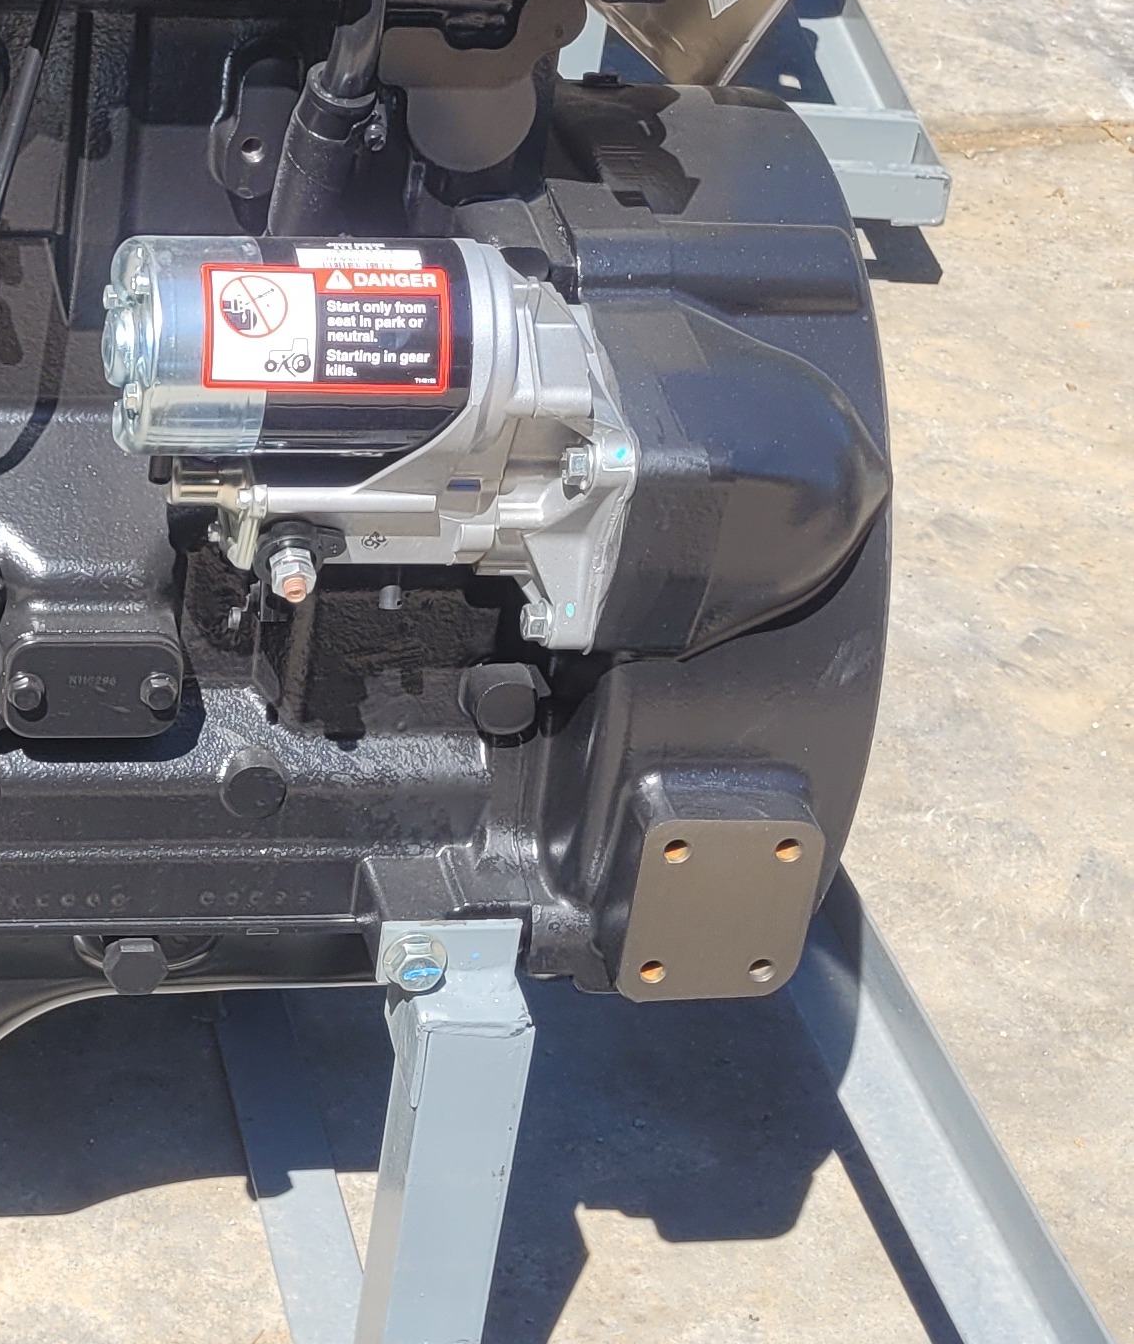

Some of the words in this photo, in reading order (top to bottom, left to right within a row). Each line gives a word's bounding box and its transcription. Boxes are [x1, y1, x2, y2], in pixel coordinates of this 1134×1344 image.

[353, 272, 437, 287] DANGER
[326, 300, 360, 312] Start
[363, 301, 392, 316] only
[394, 301, 426, 313] from
[327, 316, 356, 327] seat
[360, 315, 371, 327] in
[375, 316, 406, 330] park
[409, 319, 423, 328] or
[327, 330, 378, 342] neutral.
[326, 349, 380, 365] Starting
[384, 350, 396, 362] in
[400, 353, 430, 365] gear
[326, 364, 357, 376] kills.
